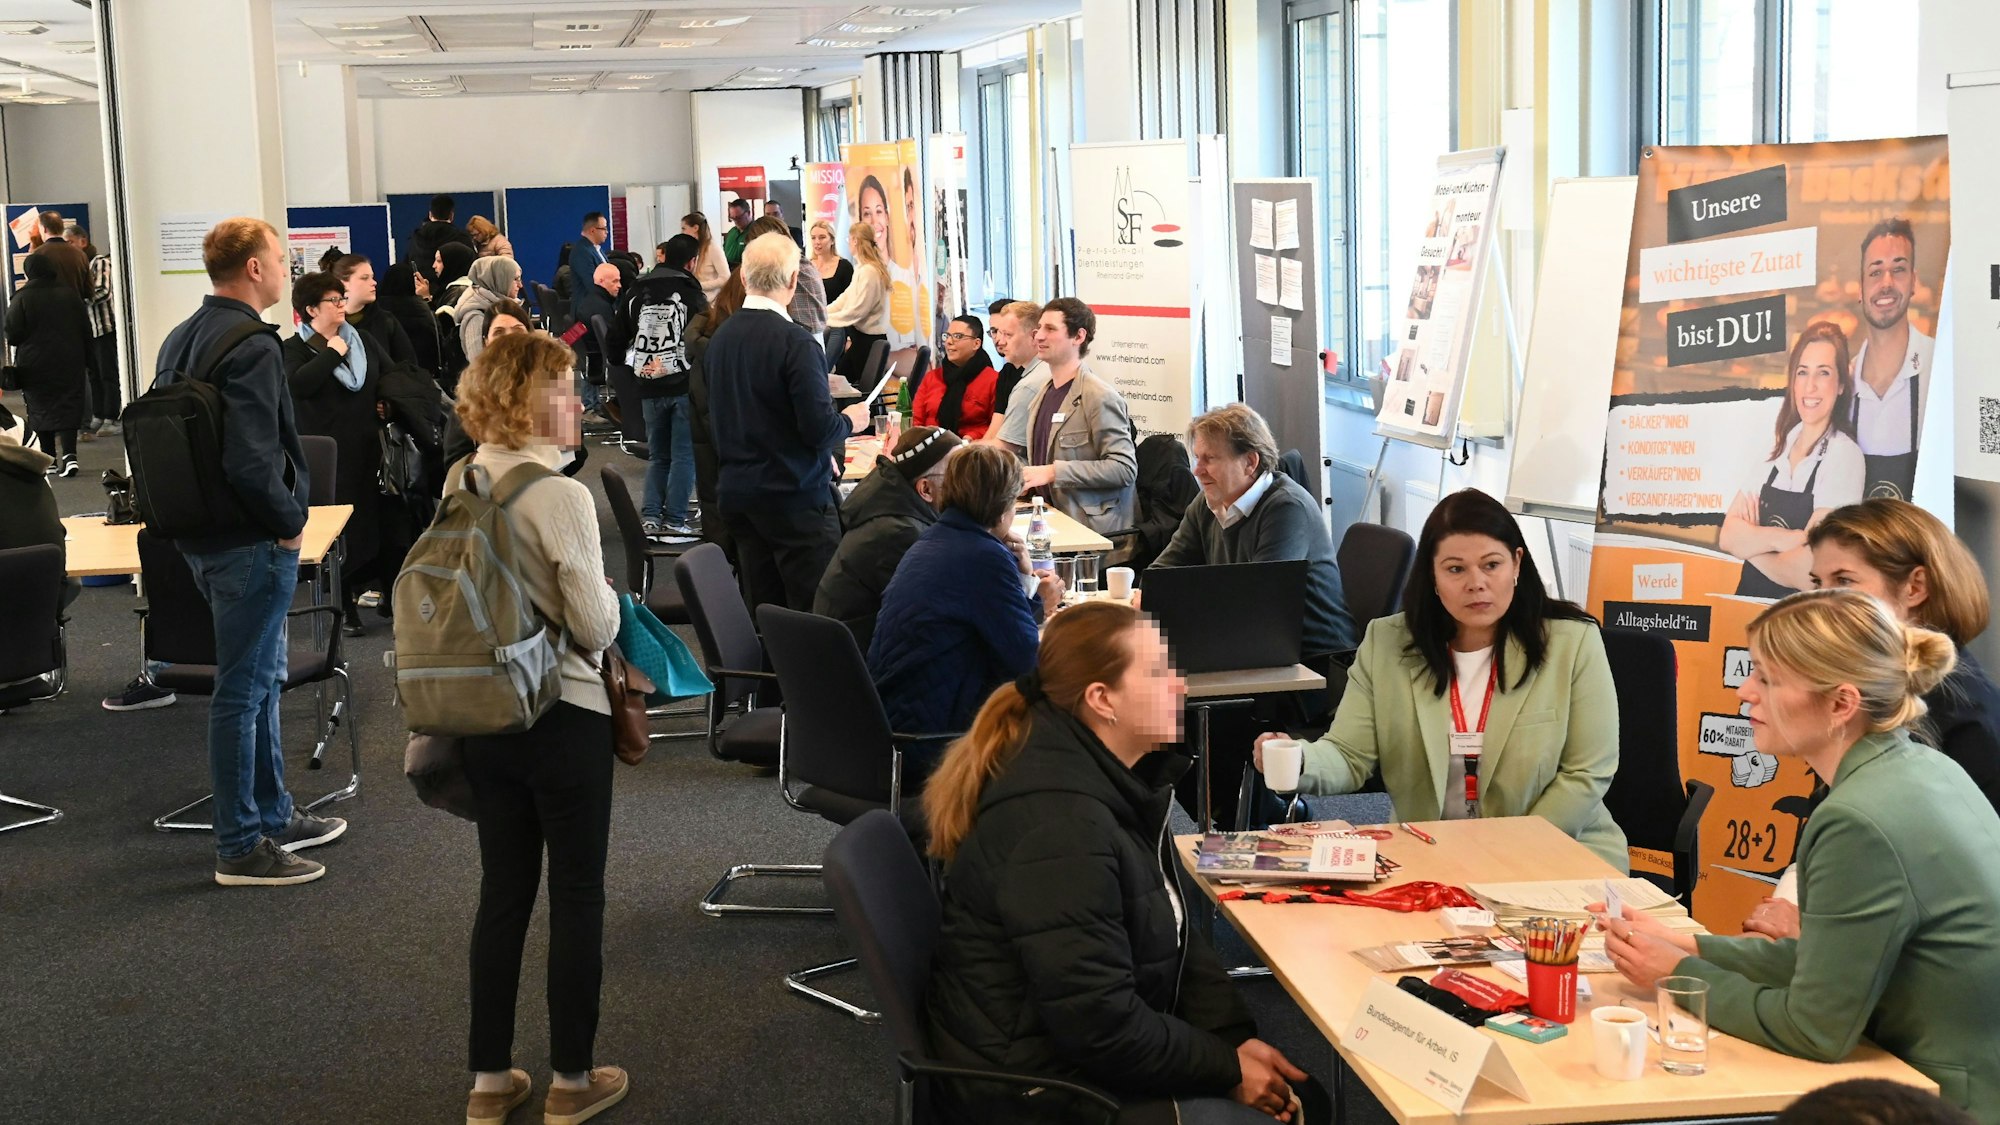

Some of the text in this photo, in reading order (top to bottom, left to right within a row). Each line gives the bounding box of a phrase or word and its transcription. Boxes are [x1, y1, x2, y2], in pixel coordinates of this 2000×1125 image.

[1691, 192, 1761, 222] Unsere
[1078, 259, 1144, 270] Dienstleistungen
[1653, 250, 1803, 286] wichtigste Zutat
[1677, 309, 1772, 348] bist DU!
[1096, 354, 1166, 365] www.sf-rheinland.com
[1637, 573, 1678, 589] Werde
[1703, 728, 1725, 744] 60%
[1724, 736, 1746, 748] RABATT
[1724, 818, 1776, 863] 28+2
[1366, 1004, 1416, 1038] Bundesagentur
[1415, 1030, 1426, 1044] für
[1355, 1026, 1369, 1041] 07
